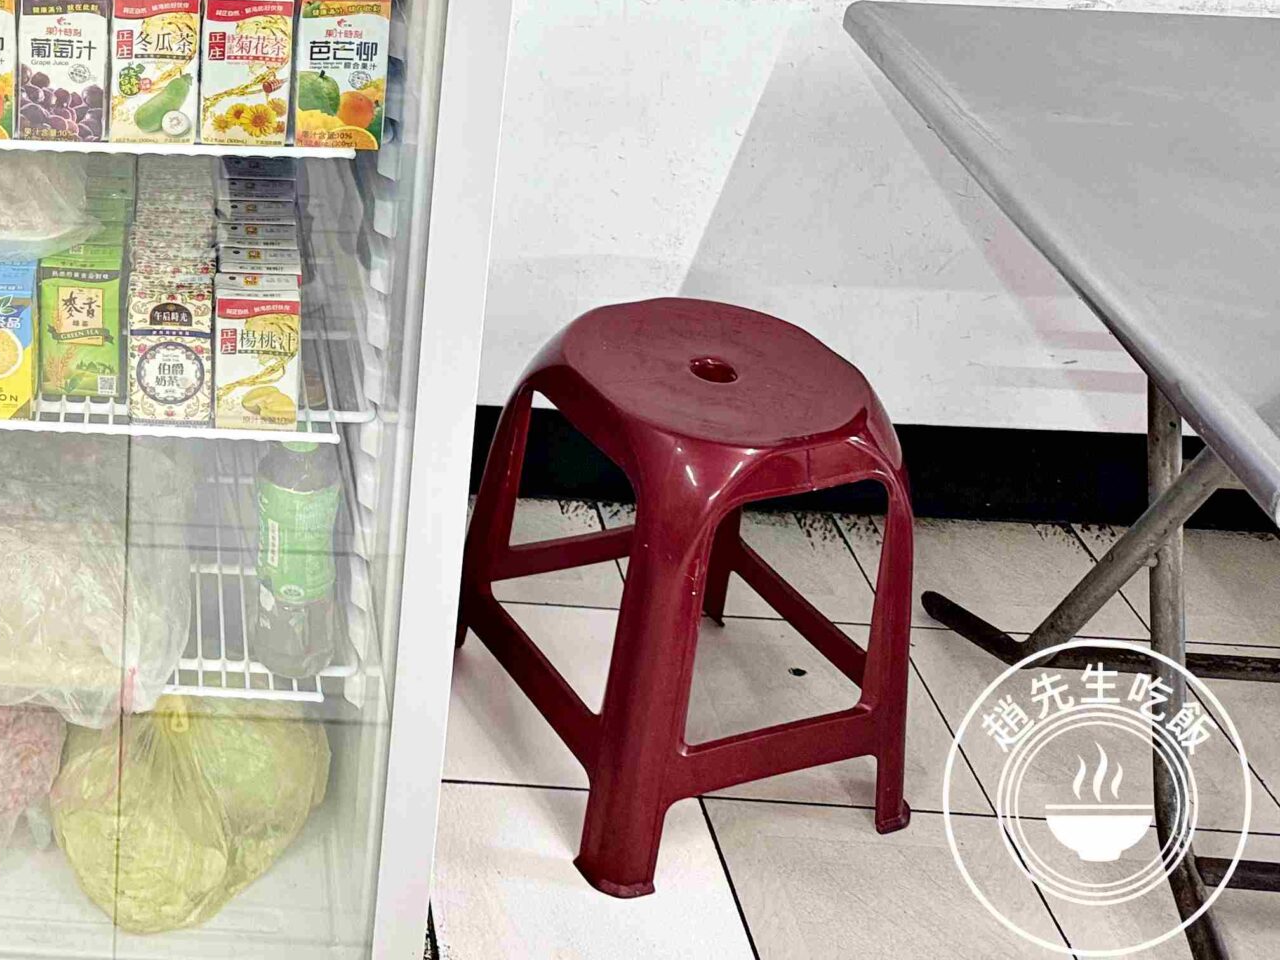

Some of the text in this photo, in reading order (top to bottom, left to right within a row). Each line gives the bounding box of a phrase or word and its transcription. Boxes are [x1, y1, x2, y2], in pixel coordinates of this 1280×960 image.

[30, 38, 97, 61] 葡萄汁
[135, 31, 194, 54] 冬瓜茶
[236, 34, 287, 56] 菊花茶
[239, 328, 293, 352] 楊桃汁
